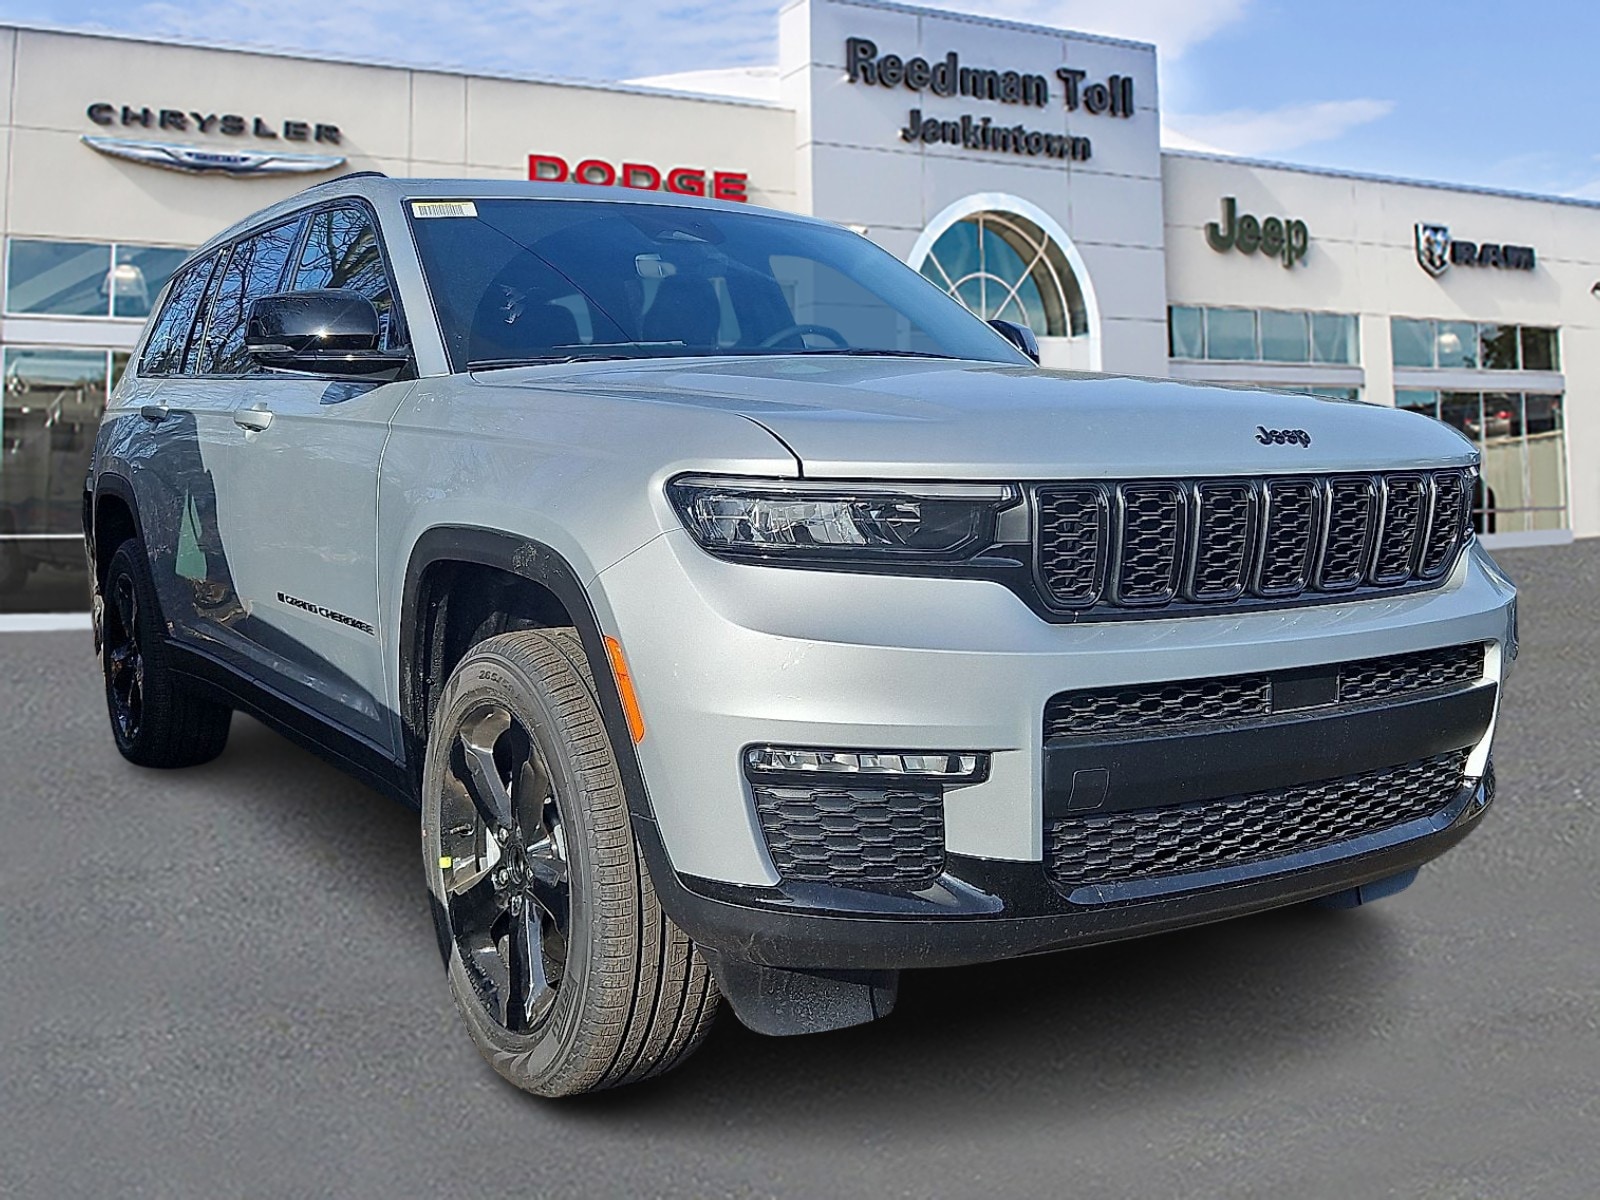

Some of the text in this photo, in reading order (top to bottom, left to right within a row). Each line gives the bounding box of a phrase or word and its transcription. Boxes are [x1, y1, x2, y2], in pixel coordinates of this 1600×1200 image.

[845, 37, 1134, 118] Reedman Toll
[86, 102, 344, 145] CHRYSLER
[900, 109, 1092, 161] Jenkintown
[528, 154, 748, 203] DODGE
[1204, 197, 1309, 269] Jeep
[1450, 240, 1535, 270] RAM
[1254, 425, 1312, 449] Jeep
[318, 606, 376, 637] CHEROKEE
